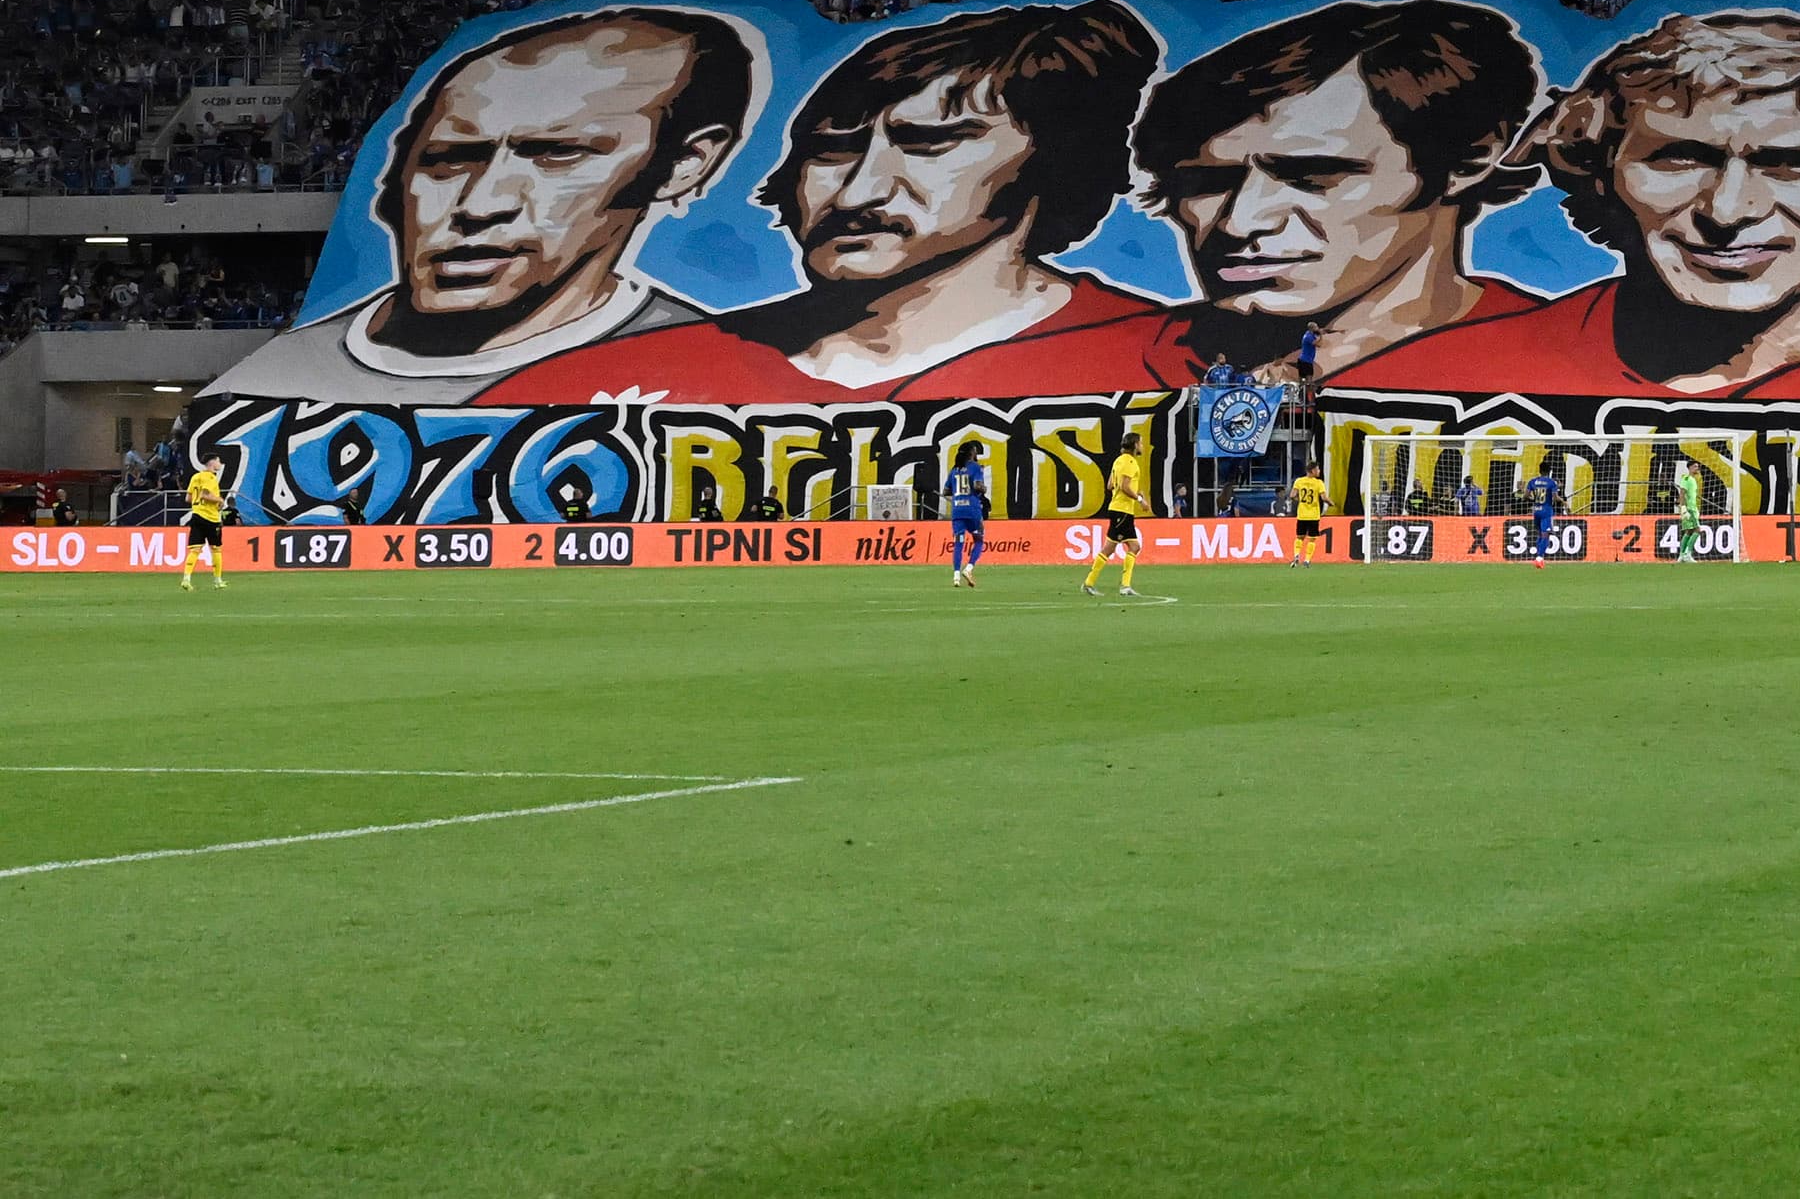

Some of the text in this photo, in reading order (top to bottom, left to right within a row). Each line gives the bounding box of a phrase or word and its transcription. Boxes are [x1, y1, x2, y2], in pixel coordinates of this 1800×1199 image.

[236, 97, 257, 105] EXIT
[1213, 392, 1267, 420] SEKTOR C
[216, 403, 630, 524] 1976
[1300, 487, 1314, 504] 23
[11, 532, 85, 567] SLO
[247, 532, 630, 564] 1 1.87 X 3.50 2 4.00
[666, 528, 822, 562] TIPNI SI
[856, 526, 916, 561] niké
[1192, 524, 1284, 559] MJA
[1320, 527, 1332, 554] 1
[1356, 525, 1429, 555] 1.87
[1468, 526, 1491, 554] X
[1623, 525, 1642, 553] 2
